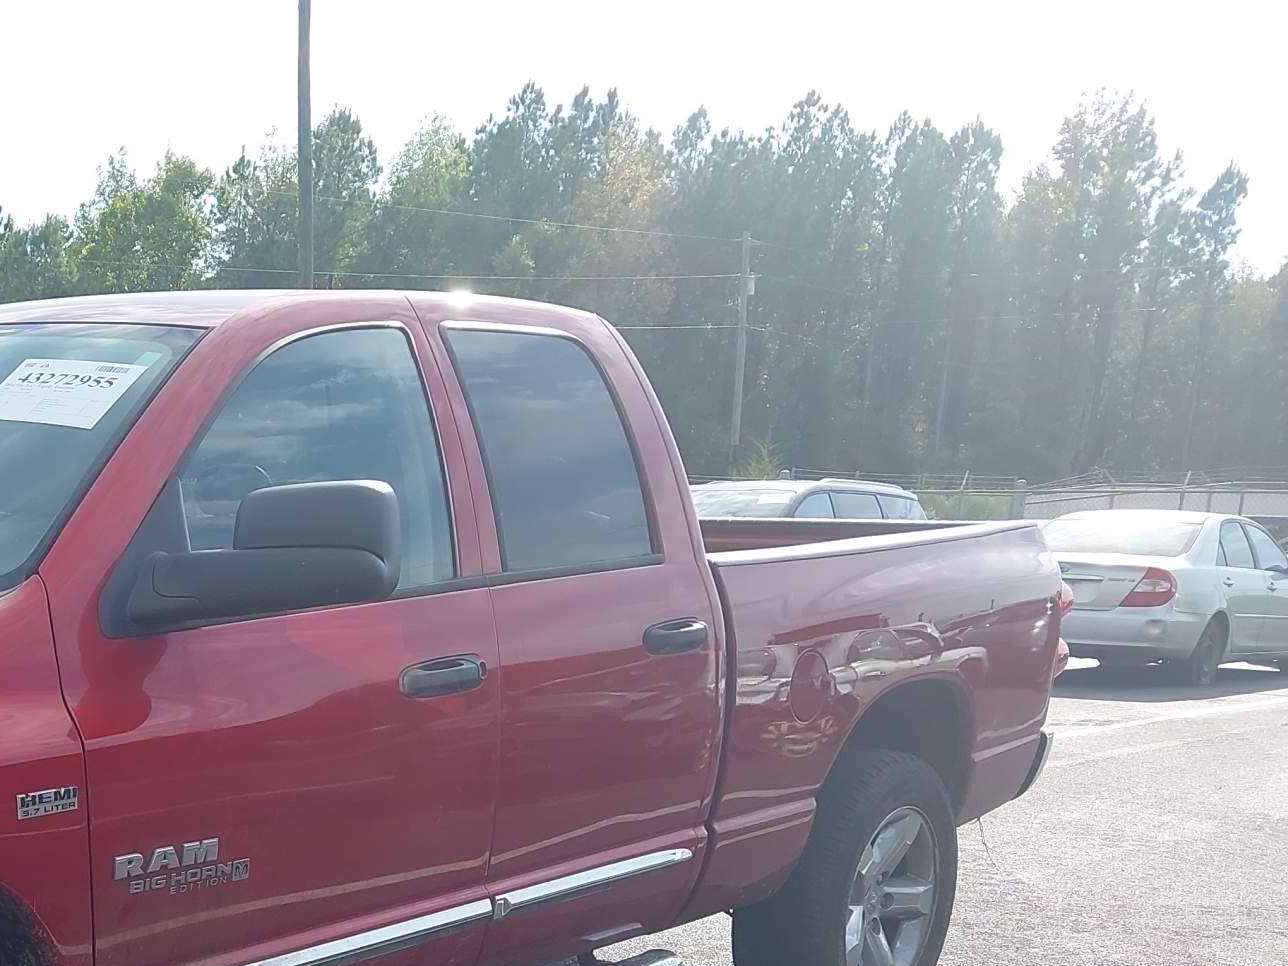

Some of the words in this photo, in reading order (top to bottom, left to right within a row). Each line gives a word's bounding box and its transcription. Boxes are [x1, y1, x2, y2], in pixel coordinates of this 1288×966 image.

[17, 371, 119, 389] 43272955
[17, 786, 78, 809] HEMI
[22, 808, 41, 818] 5.7
[44, 801, 76, 813] LITER
[113, 837, 219, 880] RAM
[129, 874, 167, 894] BIG
[170, 861, 233, 886] HORN
[170, 875, 228, 895] EDITION
